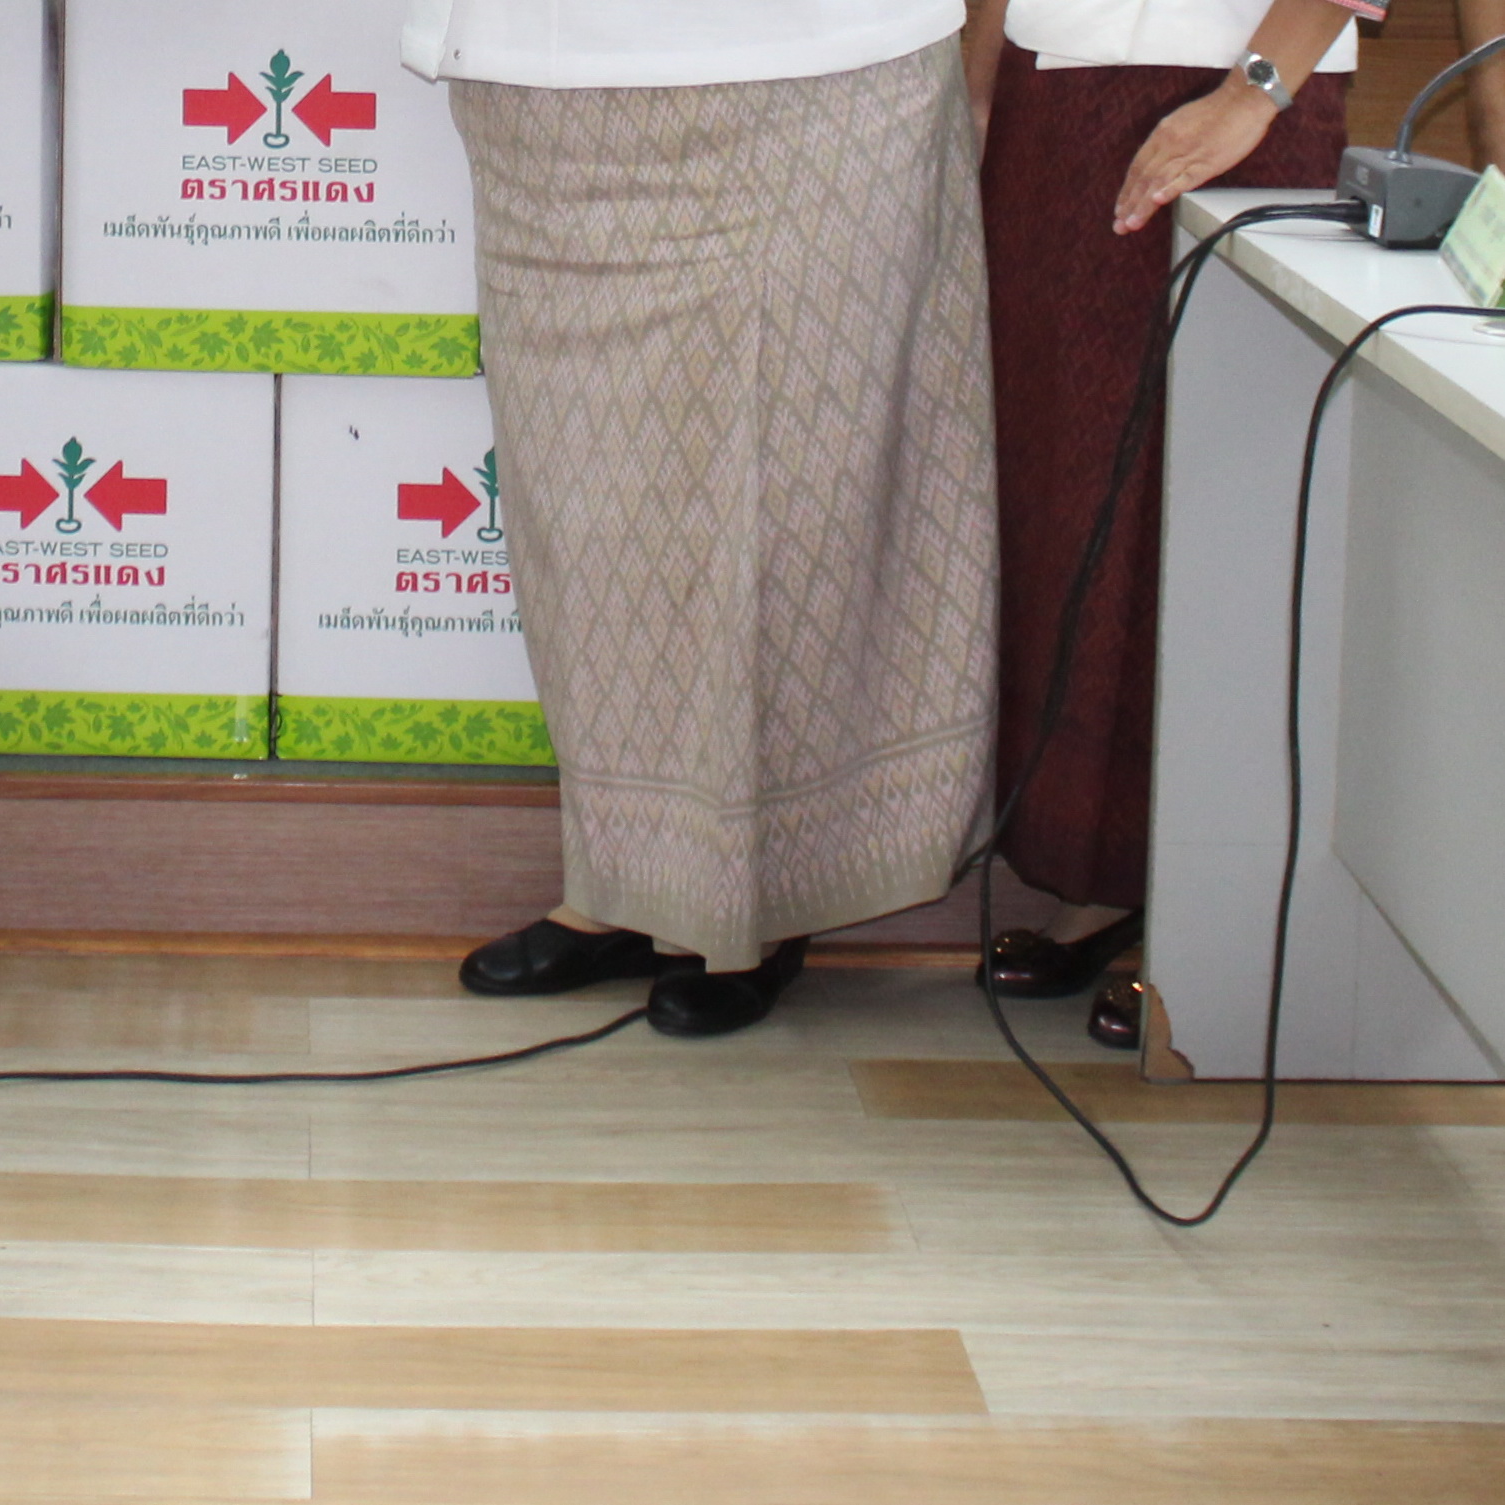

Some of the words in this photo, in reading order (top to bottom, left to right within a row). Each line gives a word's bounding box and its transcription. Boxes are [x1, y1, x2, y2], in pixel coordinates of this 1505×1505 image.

[181, 155, 312, 174] EAST-WEST
[318, 158, 378, 175] SEED
[180, 178, 375, 204] ตราศรแดง
[287, 210, 456, 245] เพื่อผลผลิตที่ดีกว่า
[109, 543, 169, 560] SEED
[397, 548, 510, 567] EAST-WES
[395, 571, 511, 596] ตราศร
[79, 594, 245, 628] เพื่อผลผลิตที่ดีกว่า
